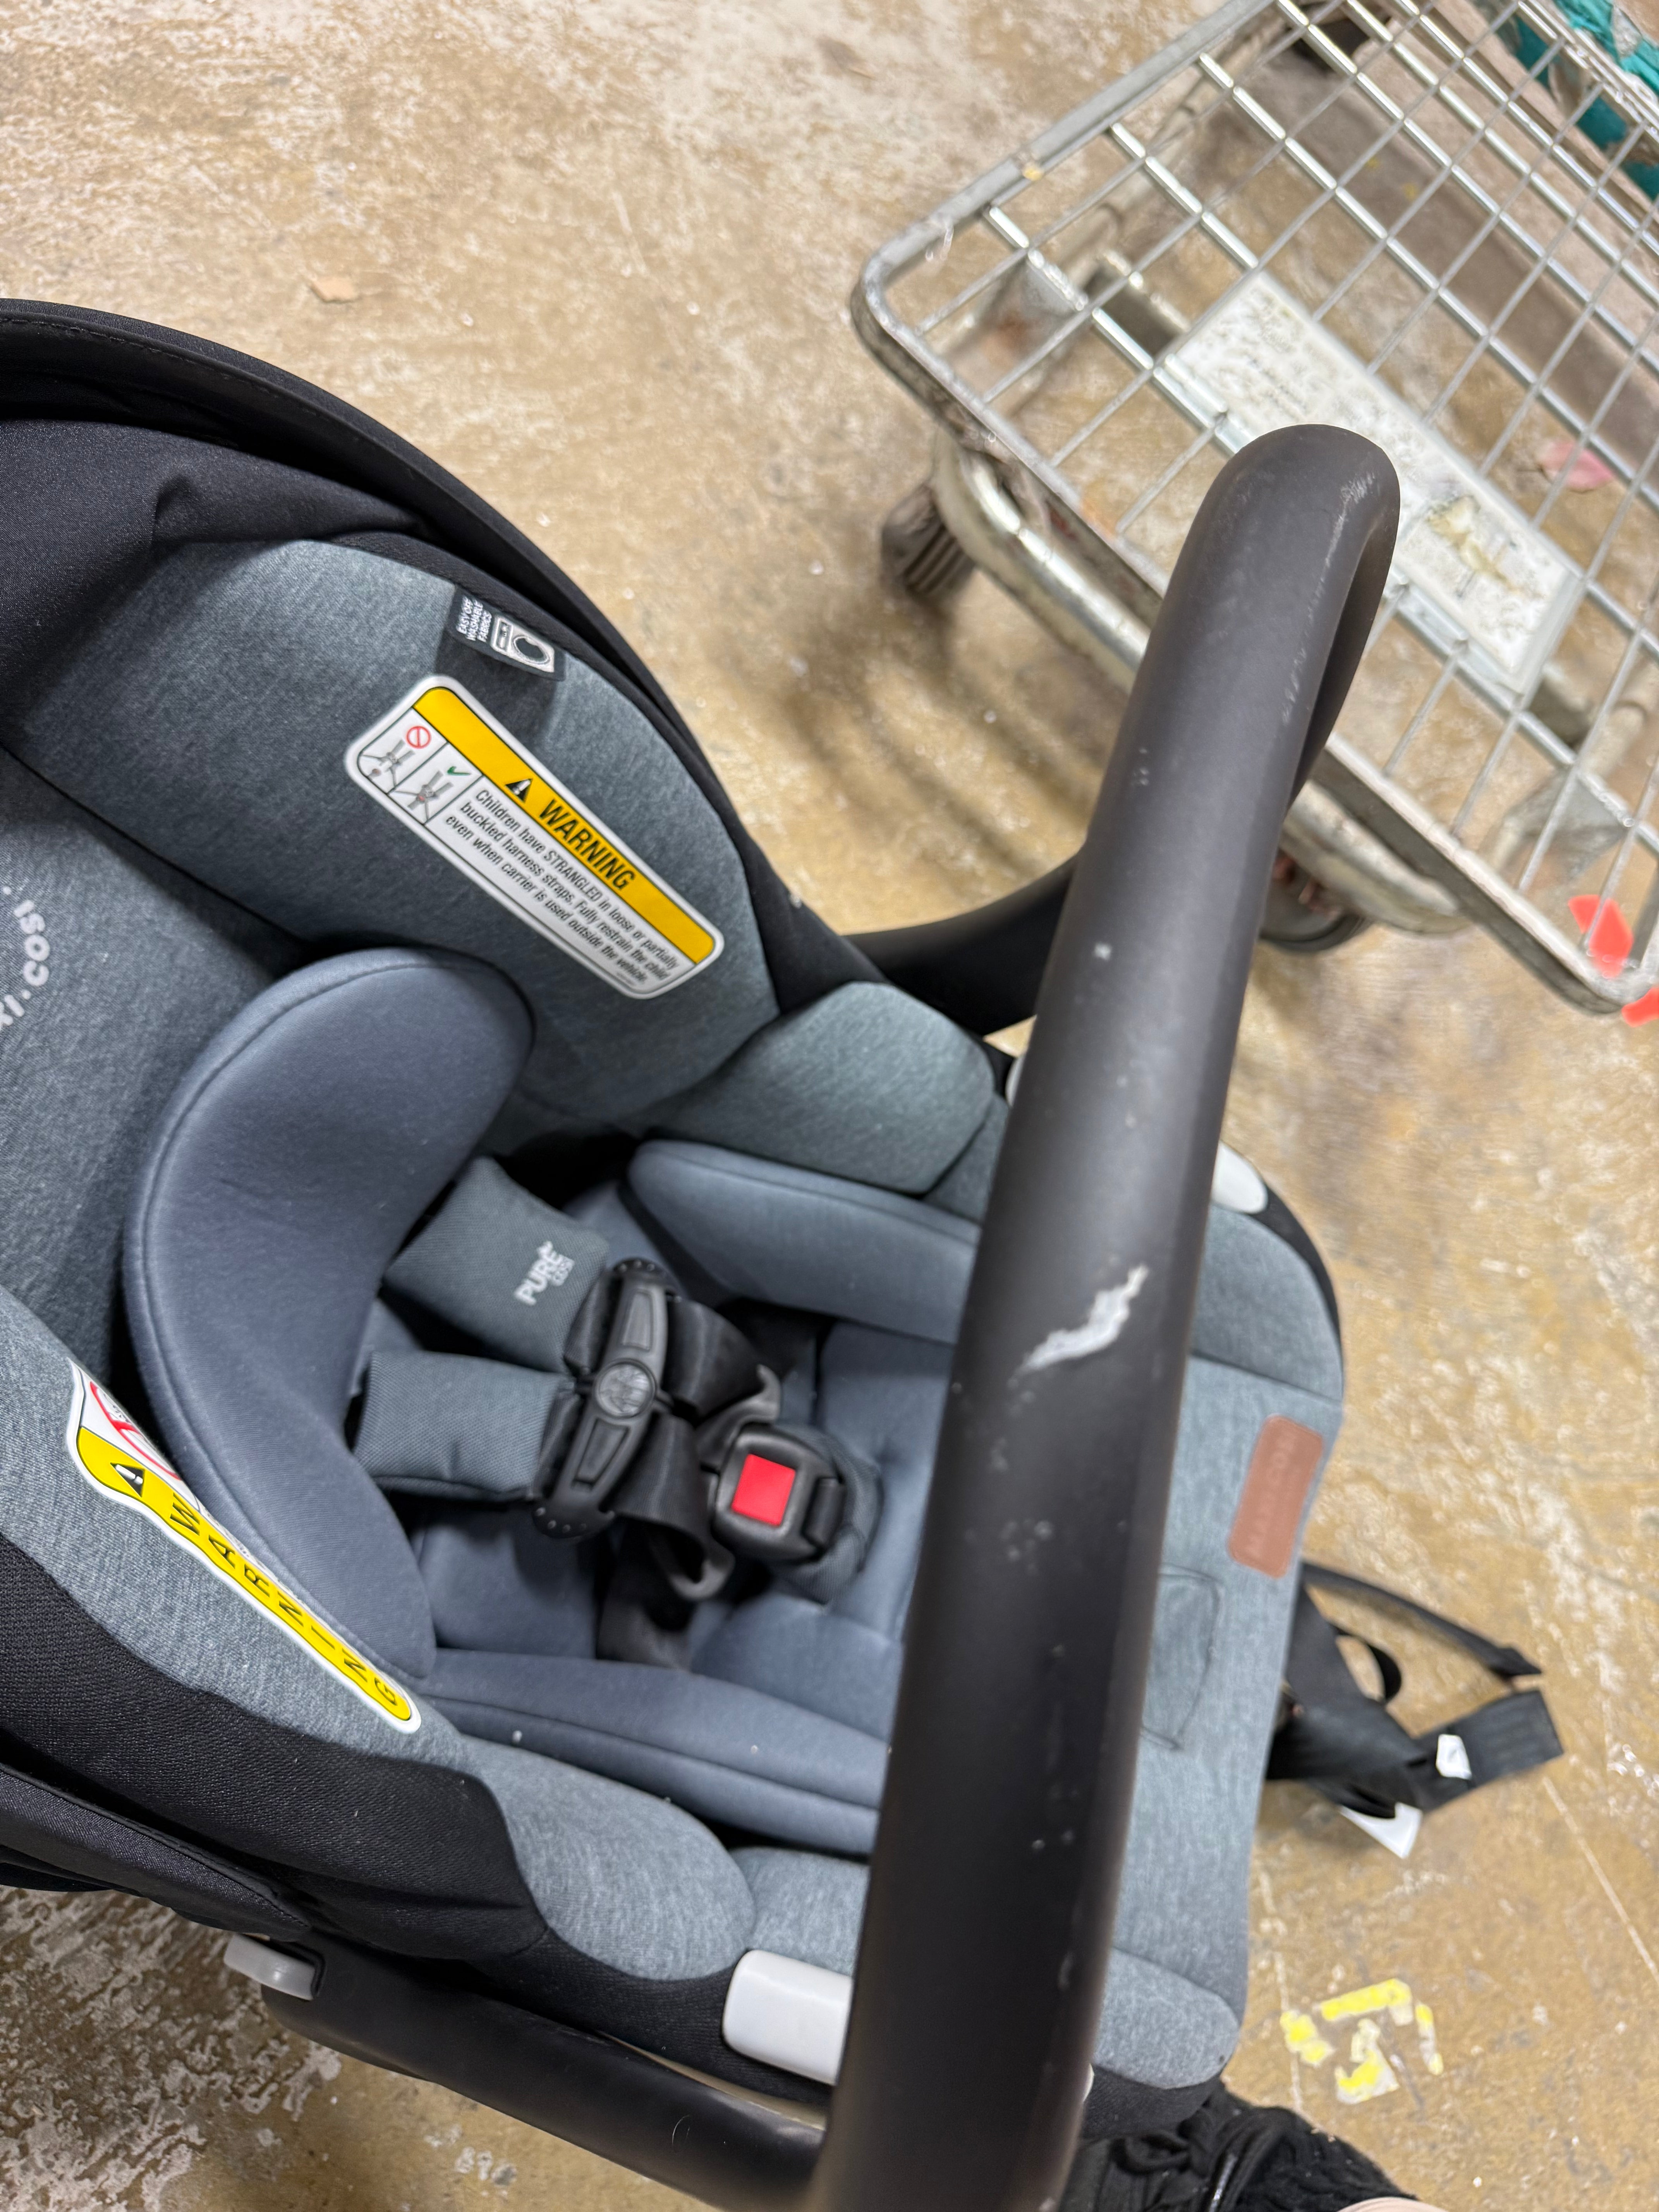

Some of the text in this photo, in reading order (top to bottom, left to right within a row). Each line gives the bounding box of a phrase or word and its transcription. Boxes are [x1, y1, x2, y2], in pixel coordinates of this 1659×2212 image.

[456, 612, 469, 634] EASY
[466, 600, 483, 641] WASHABLE
[446, 816, 473, 840] even
[472, 838, 503, 864] when
[501, 863, 537, 892] carrier
[534, 890, 547, 901] is
[544, 900, 573, 921] used
[568, 920, 603, 948] outside
[601, 946, 617, 958] the
[460, 802, 507, 842] buckled
[502, 838, 544, 876] harness
[542, 874, 574, 905] straps.
[574, 900, 599, 924] Fully
[597, 922, 633, 952] restrain
[630, 949, 647, 962] the
[476, 790, 678, 970] Children have STRANGLED in loose or partially
[539, 799, 635, 890] WARNING
[515, 1241, 563, 1305] PURE
[170, 1492, 397, 1706] WARNING
